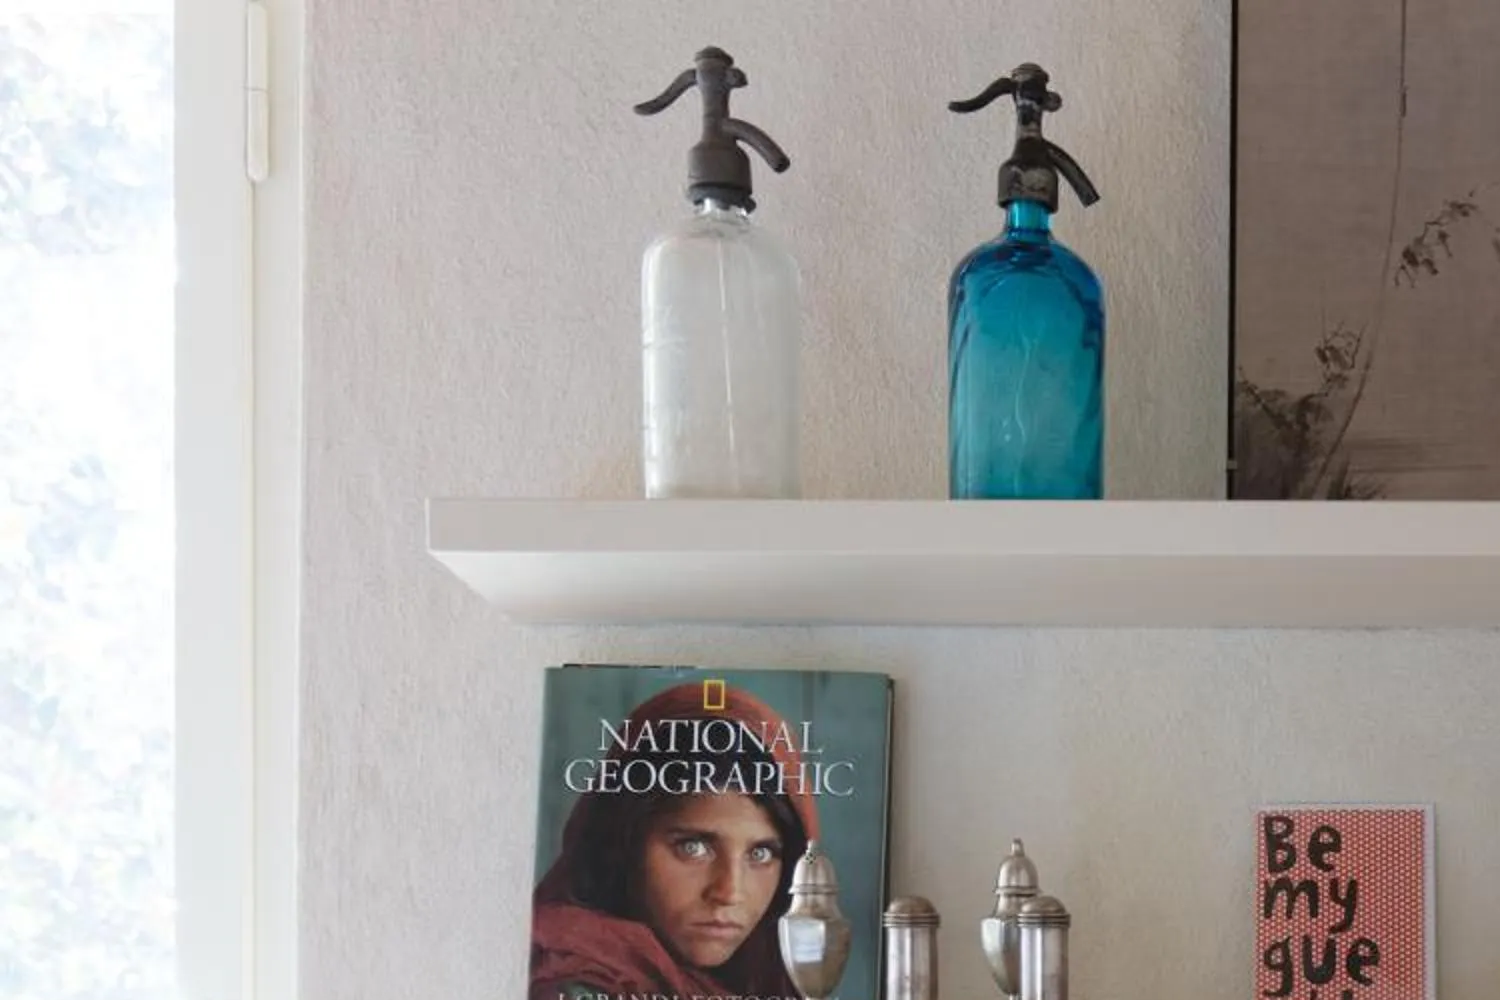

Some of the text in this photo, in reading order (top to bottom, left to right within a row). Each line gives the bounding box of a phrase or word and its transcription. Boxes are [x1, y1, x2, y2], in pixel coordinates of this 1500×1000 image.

[598, 719, 823, 754] NATIONAL
[564, 758, 854, 796] GEOGRAPHIC
[1264, 816, 1342, 873] Be
[1264, 877, 1358, 934] my
